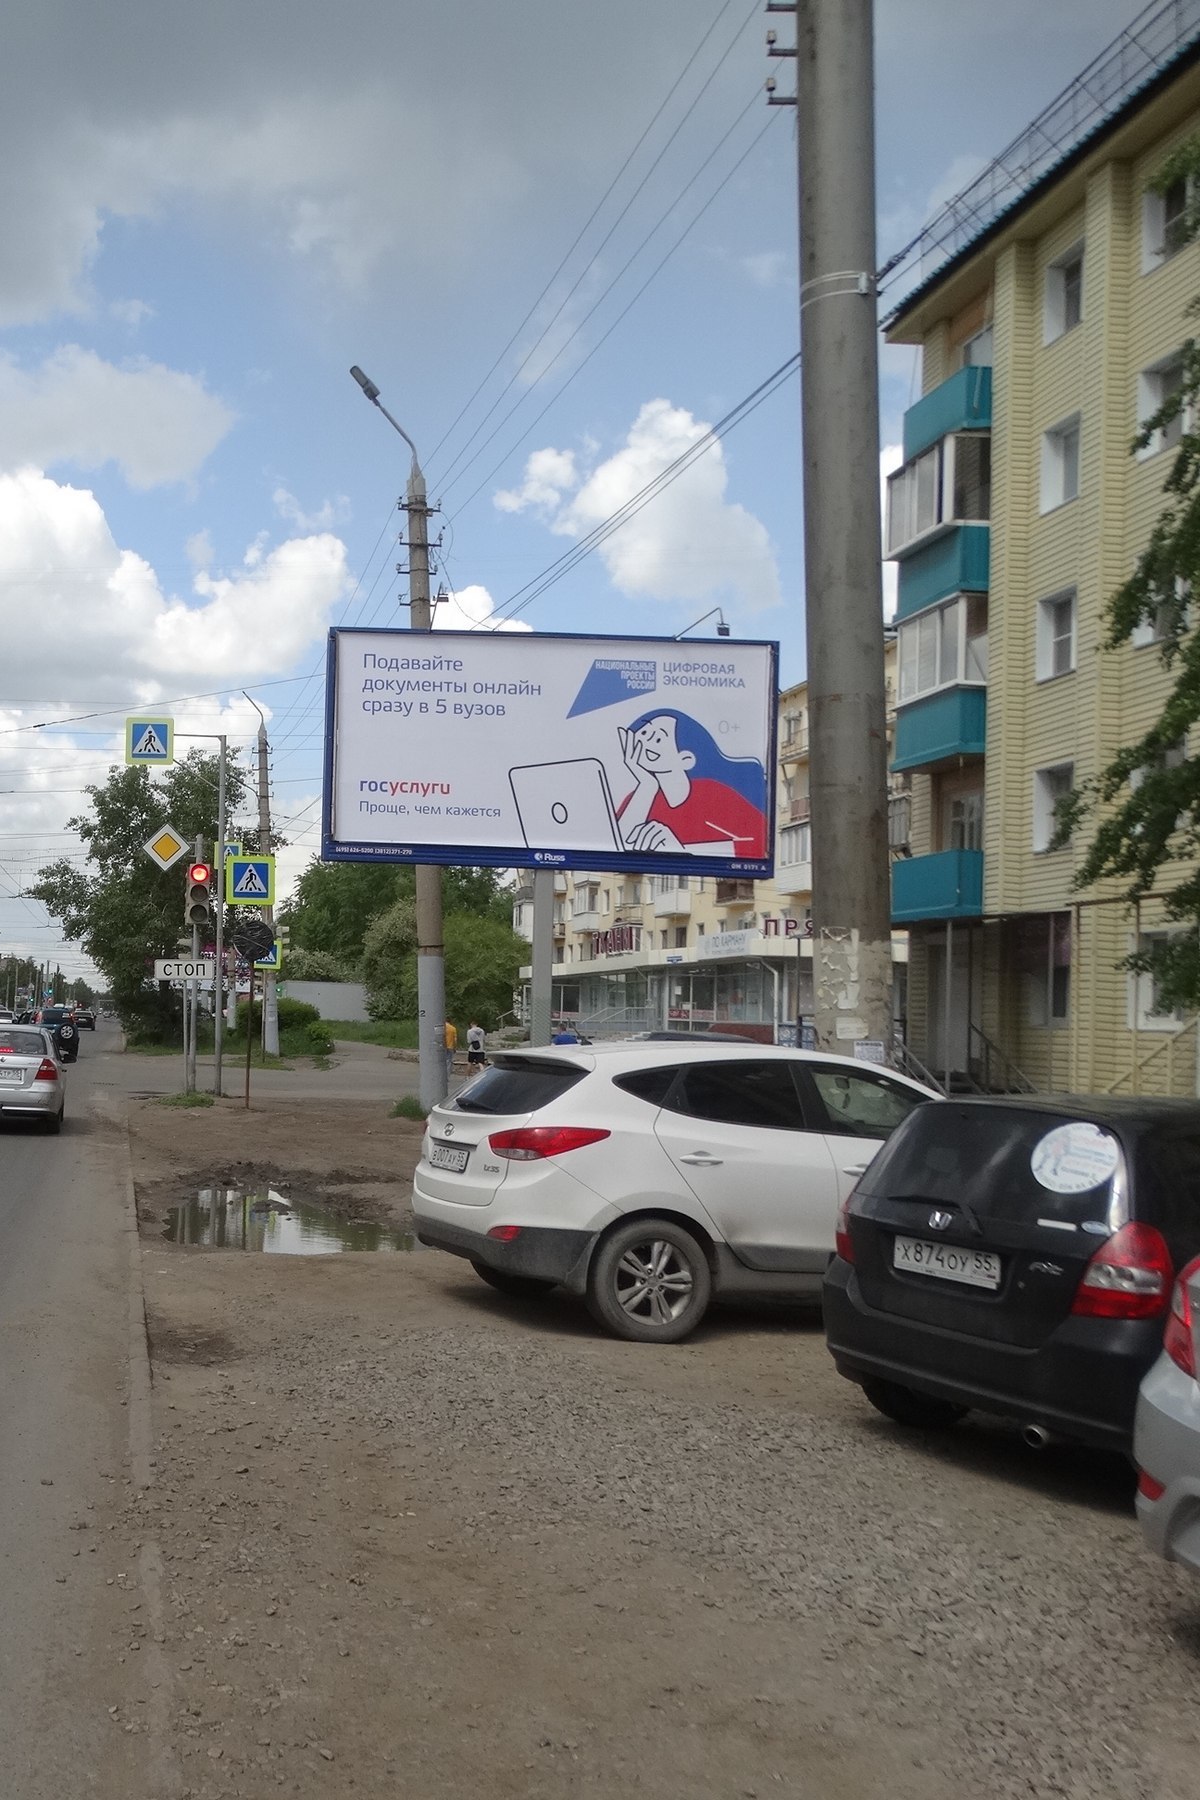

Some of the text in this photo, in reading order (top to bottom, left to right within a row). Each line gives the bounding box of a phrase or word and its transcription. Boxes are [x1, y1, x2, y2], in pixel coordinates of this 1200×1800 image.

[363, 653, 463, 672] Подавайте
[595, 660, 655, 671] НАЦИОНАЛЬНЫЕ
[663, 662, 735, 675] ЦИФРОВАЯ
[620, 670, 655, 680] ПРОЕКТЫ
[663, 675, 746, 688] ЭКОНОМИКА
[362, 678, 541, 696] документы онлайн
[626, 680, 655, 690] РОССИИ
[362, 699, 506, 719] сразу в 5 вузов
[359, 780, 450, 797] госуслуги
[359, 801, 501, 817] Проще, чем кажется
[544, 853, 566, 861] Russ
[163, 963, 206, 976] СТОП
